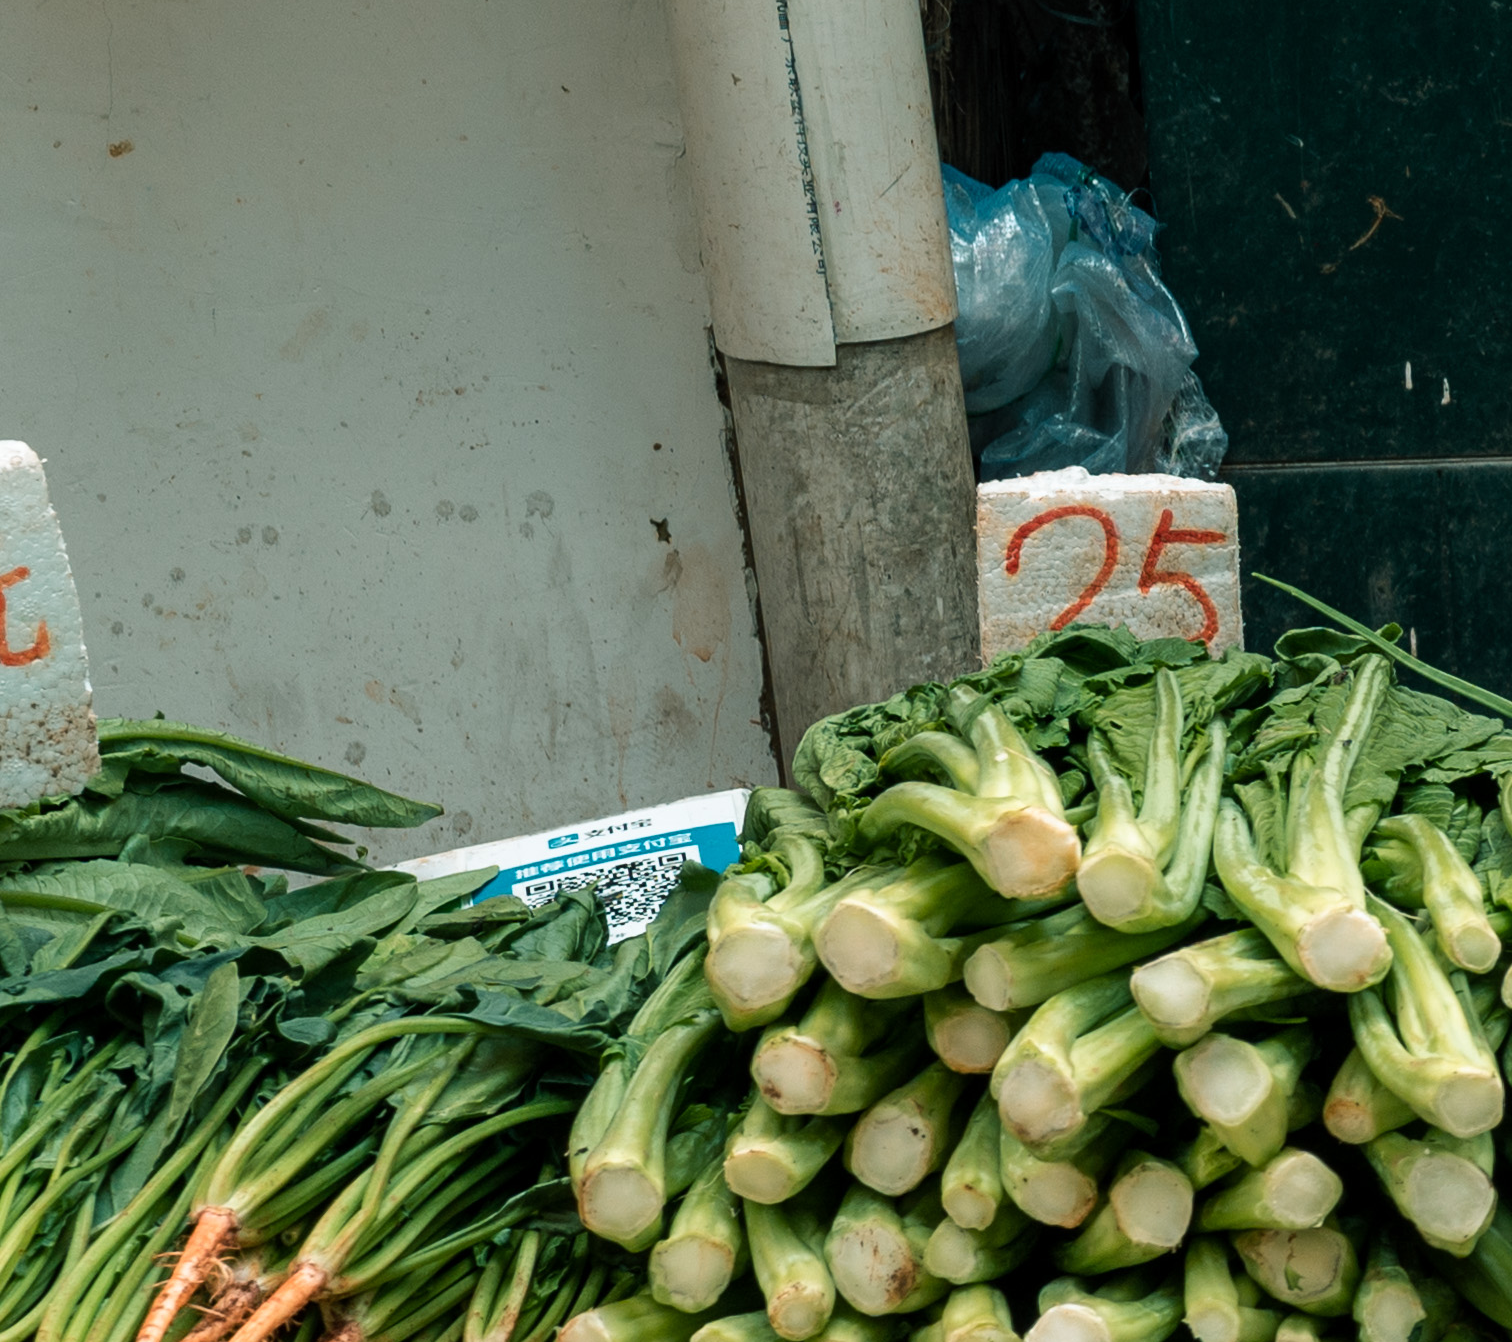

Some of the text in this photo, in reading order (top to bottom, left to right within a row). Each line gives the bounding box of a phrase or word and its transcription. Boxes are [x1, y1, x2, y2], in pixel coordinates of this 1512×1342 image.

[584, 817, 653, 841] 支付宝
[515, 832, 694, 881] 推荐使用支付宝
